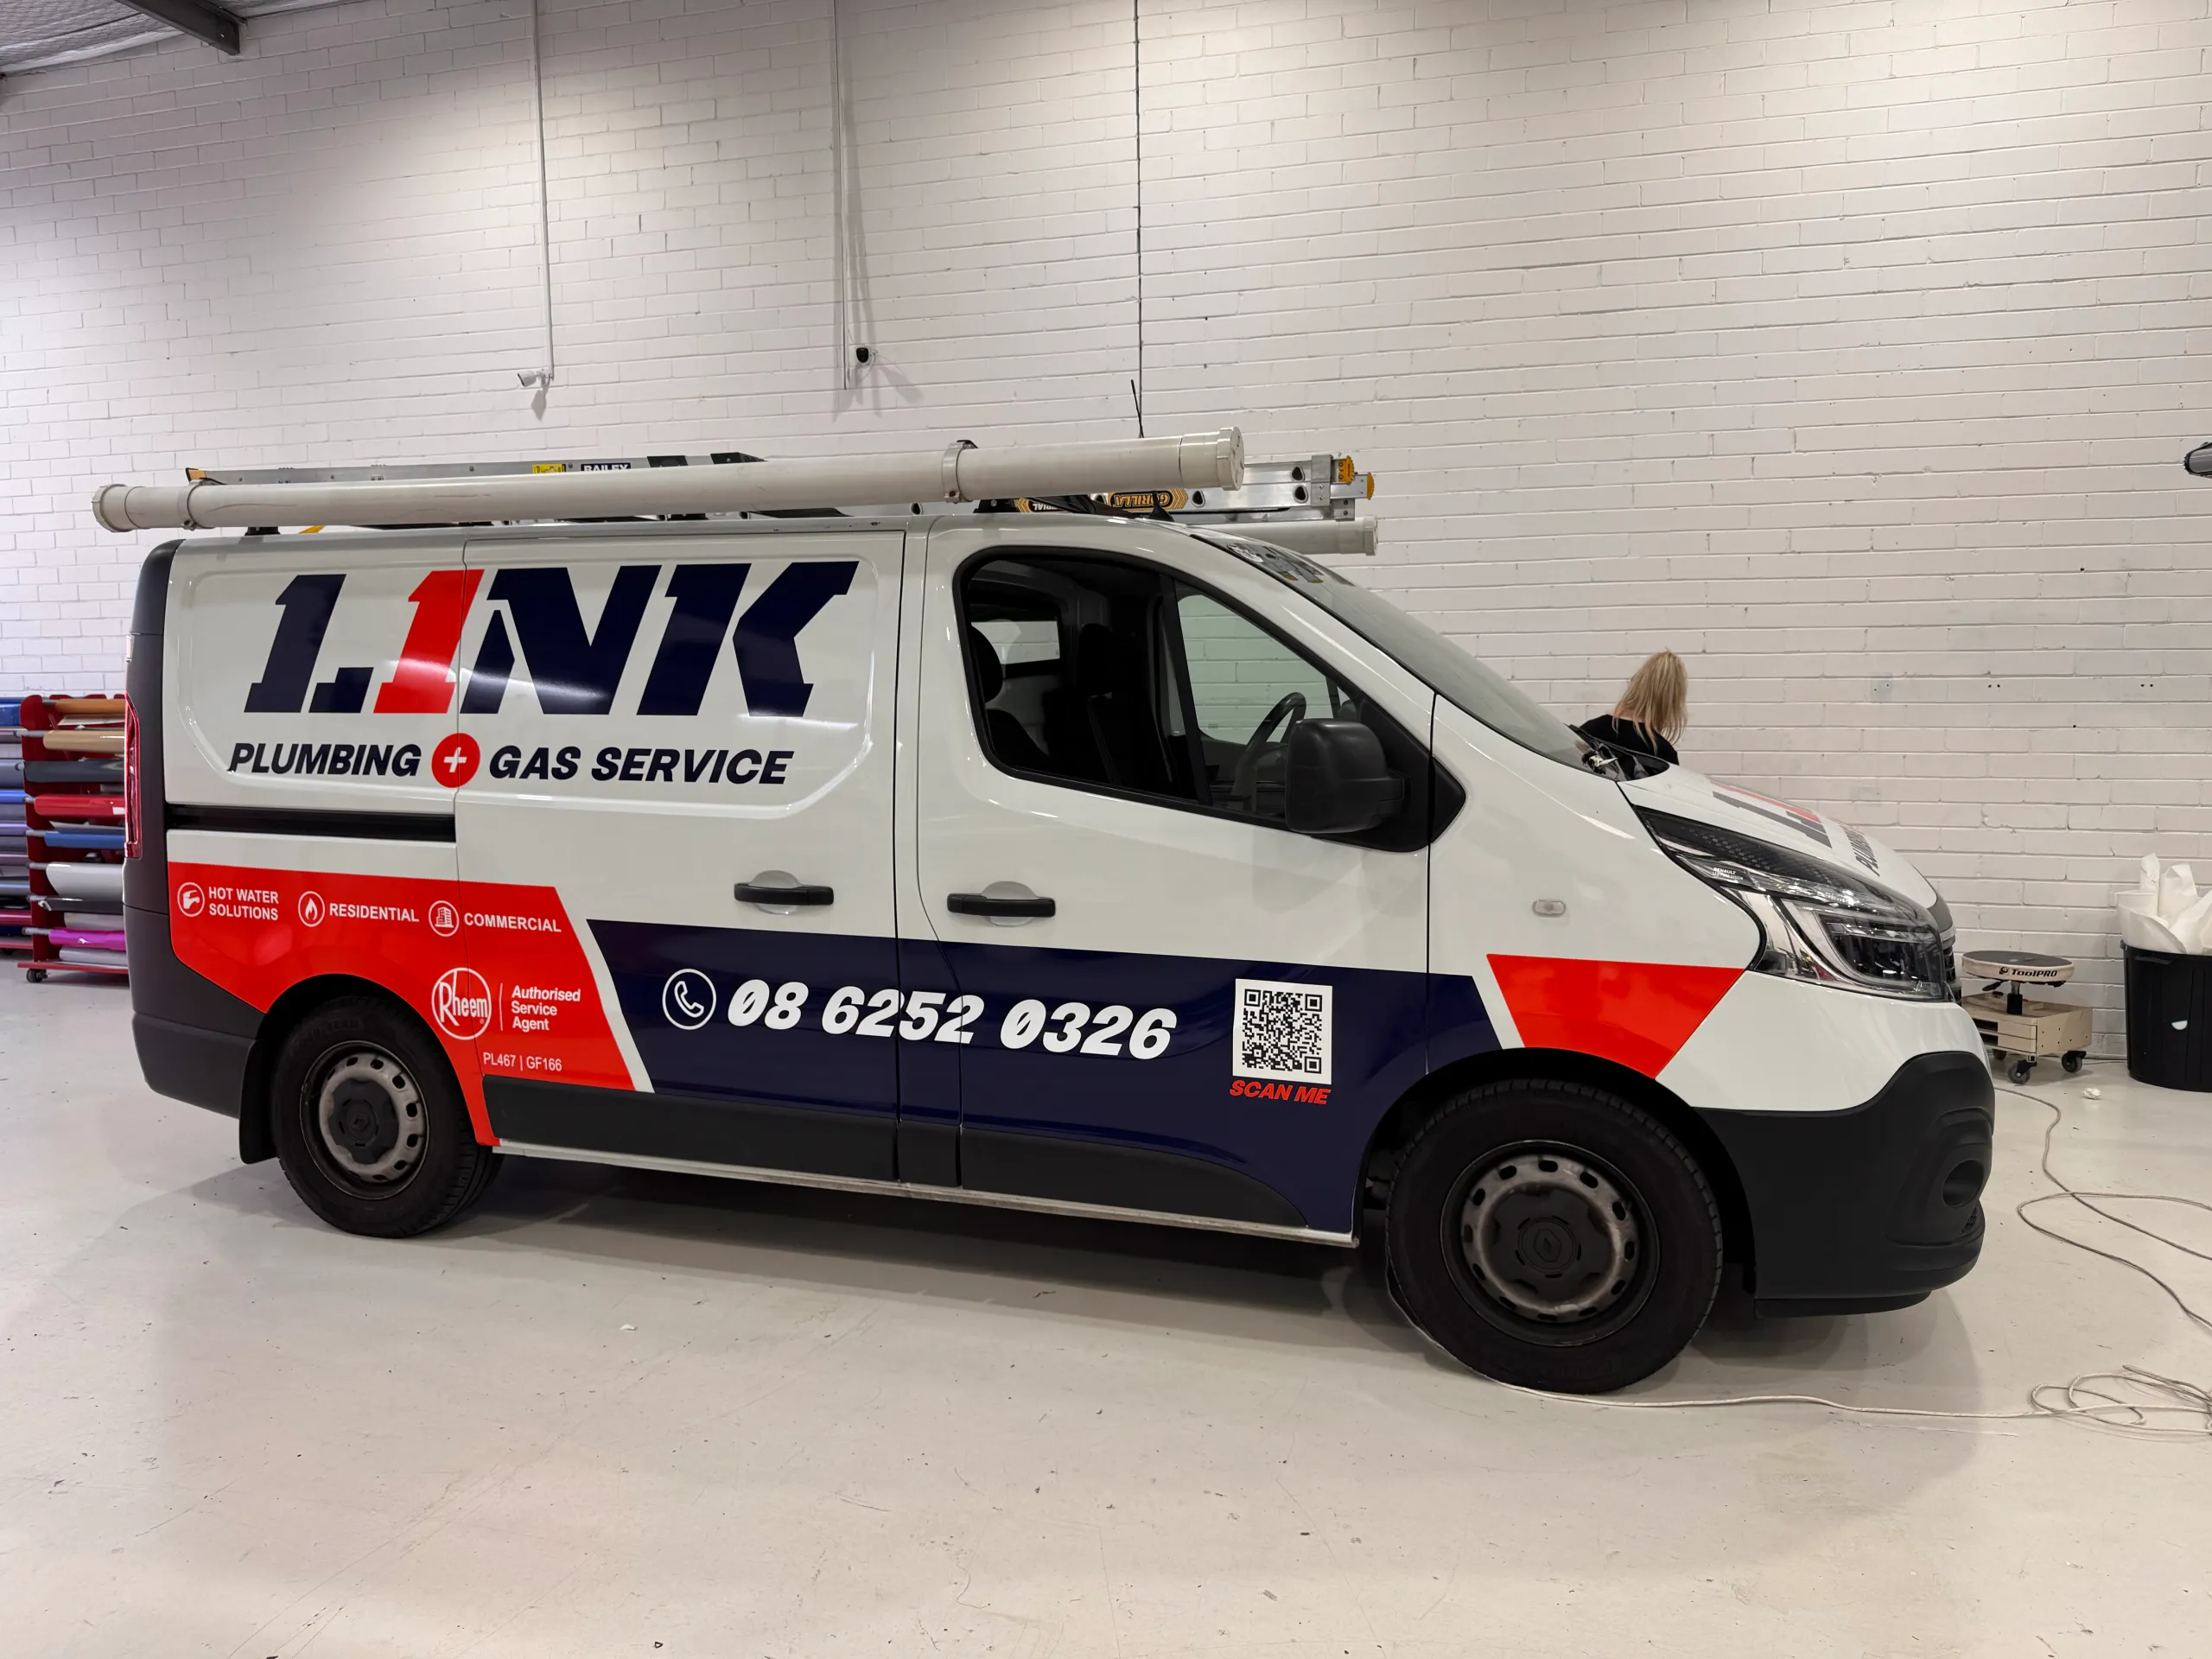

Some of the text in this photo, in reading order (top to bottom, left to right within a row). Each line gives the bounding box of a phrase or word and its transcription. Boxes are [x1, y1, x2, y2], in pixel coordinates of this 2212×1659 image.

[228, 743, 422, 777] PLUMBING
[489, 746, 582, 780] GAS
[592, 747, 795, 785] SERVICE
[208, 886, 279, 905] HOT WATER
[208, 902, 279, 921] SOLUTIONS
[329, 902, 420, 923] RESIDENTIAL
[463, 912, 562, 933] COMMERCIAL
[2011, 969, 2058, 977] ToolPRO
[438, 970, 489, 1027] Rheem
[512, 985, 582, 1002] Authorised
[511, 1001, 558, 1016] Service
[512, 1016, 550, 1033] Agent
[728, 979, 1179, 1060] 08 6252 0326
[483, 1052, 517, 1068] PL467
[525, 1055, 563, 1072] GF166
[1230, 1079, 1332, 1105] SCAN ME
